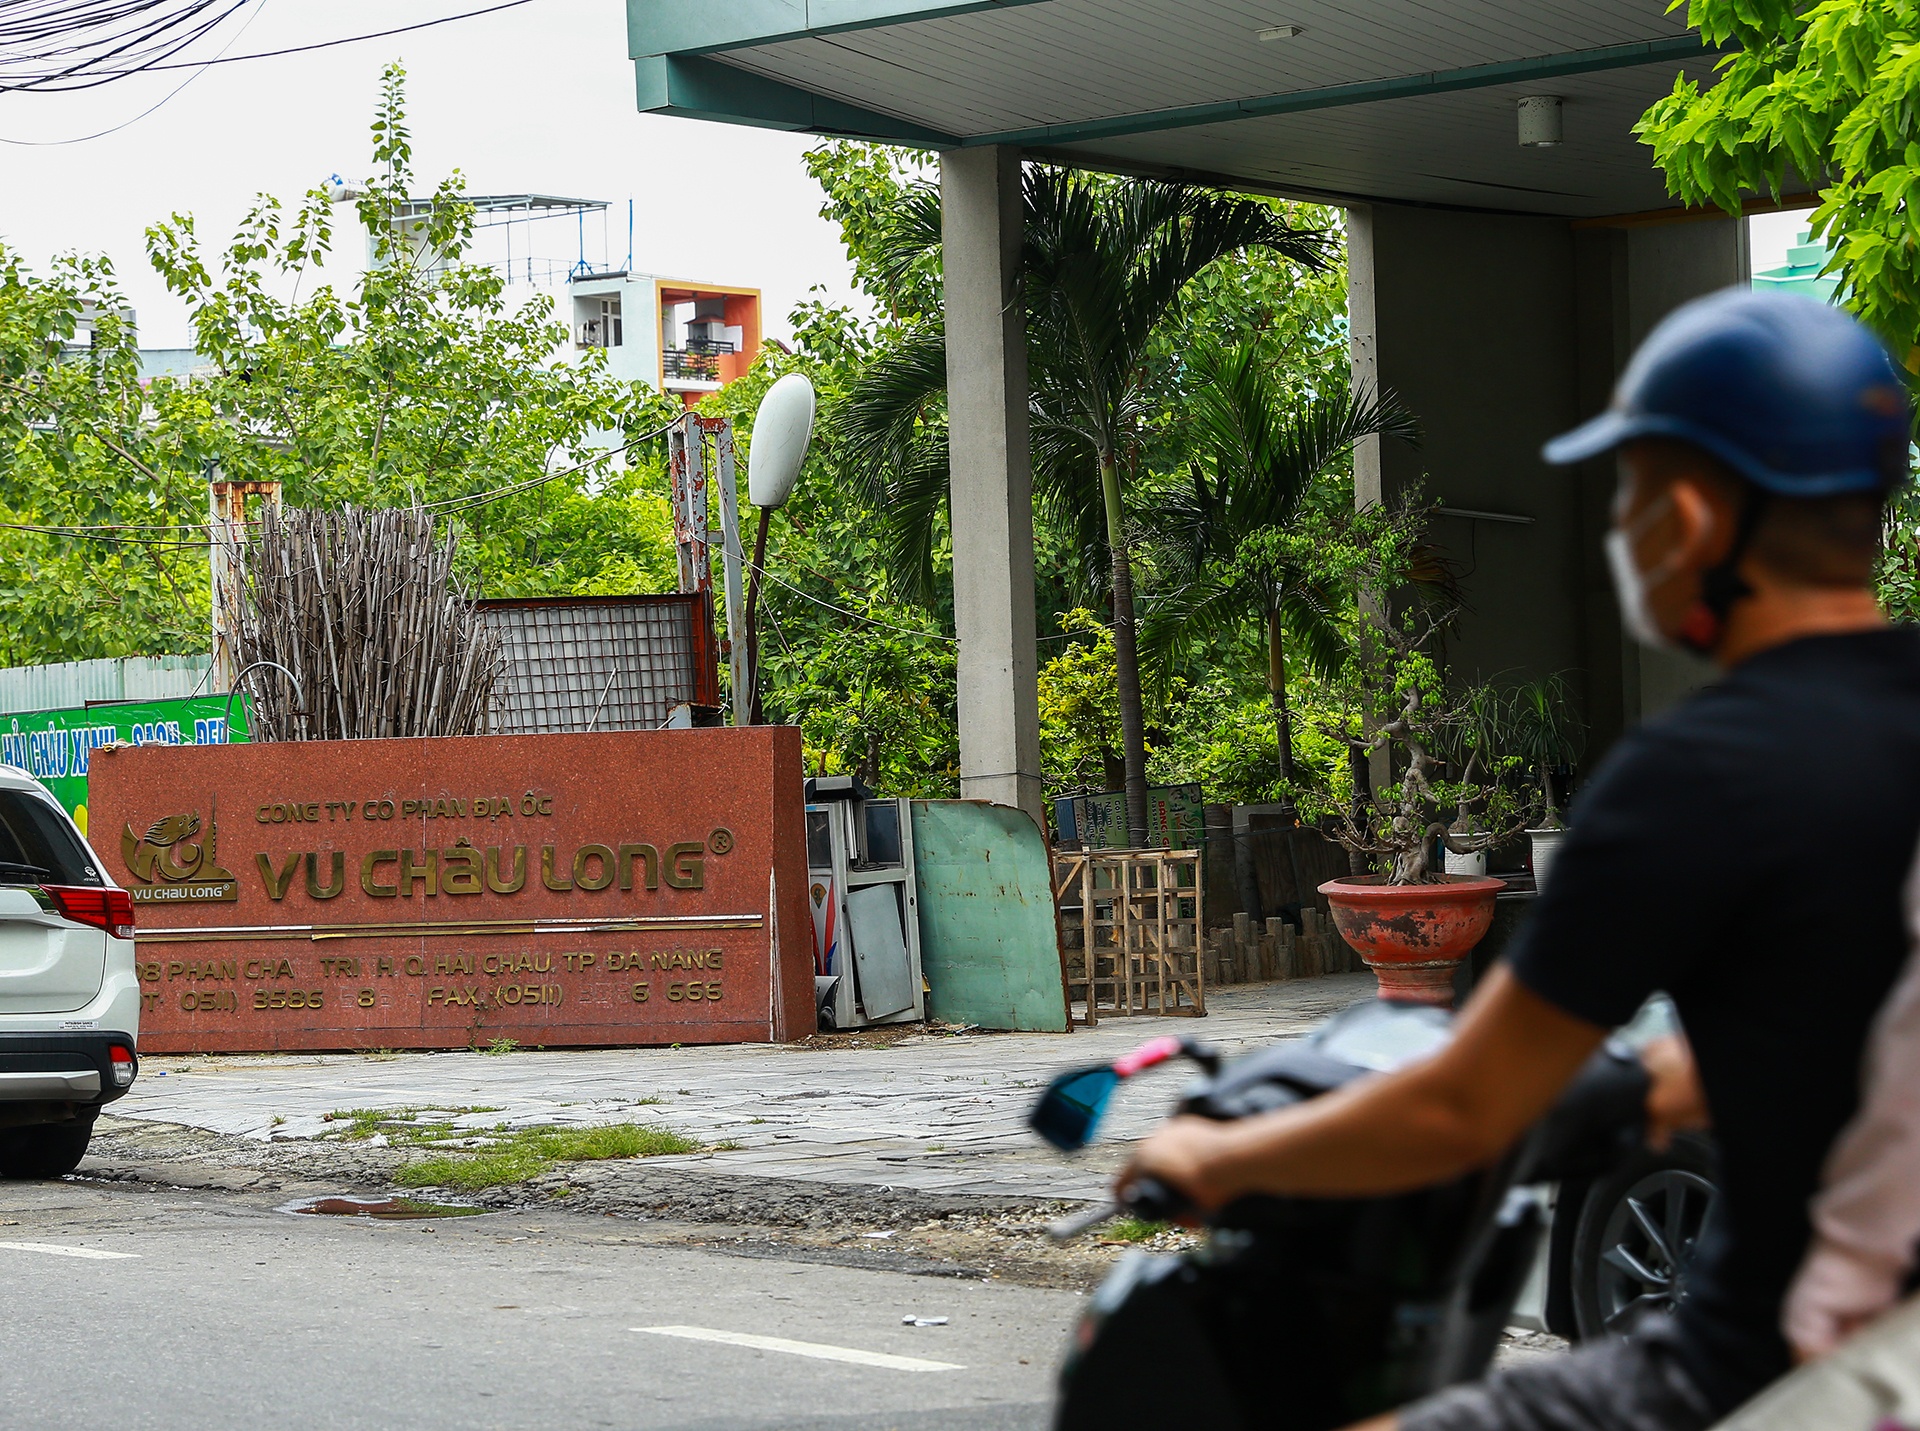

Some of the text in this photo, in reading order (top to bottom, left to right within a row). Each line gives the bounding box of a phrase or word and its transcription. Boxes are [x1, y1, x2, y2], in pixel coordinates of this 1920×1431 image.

[30, 721, 68, 779] CHÂU
[325, 801, 357, 821] TY
[1151, 795, 1160, 831] Massage
[541, 841, 704, 891] LONG
[133, 888, 152, 900] VU
[168, 959, 237, 981] PHAN
[254, 988, 323, 1010] 3586
